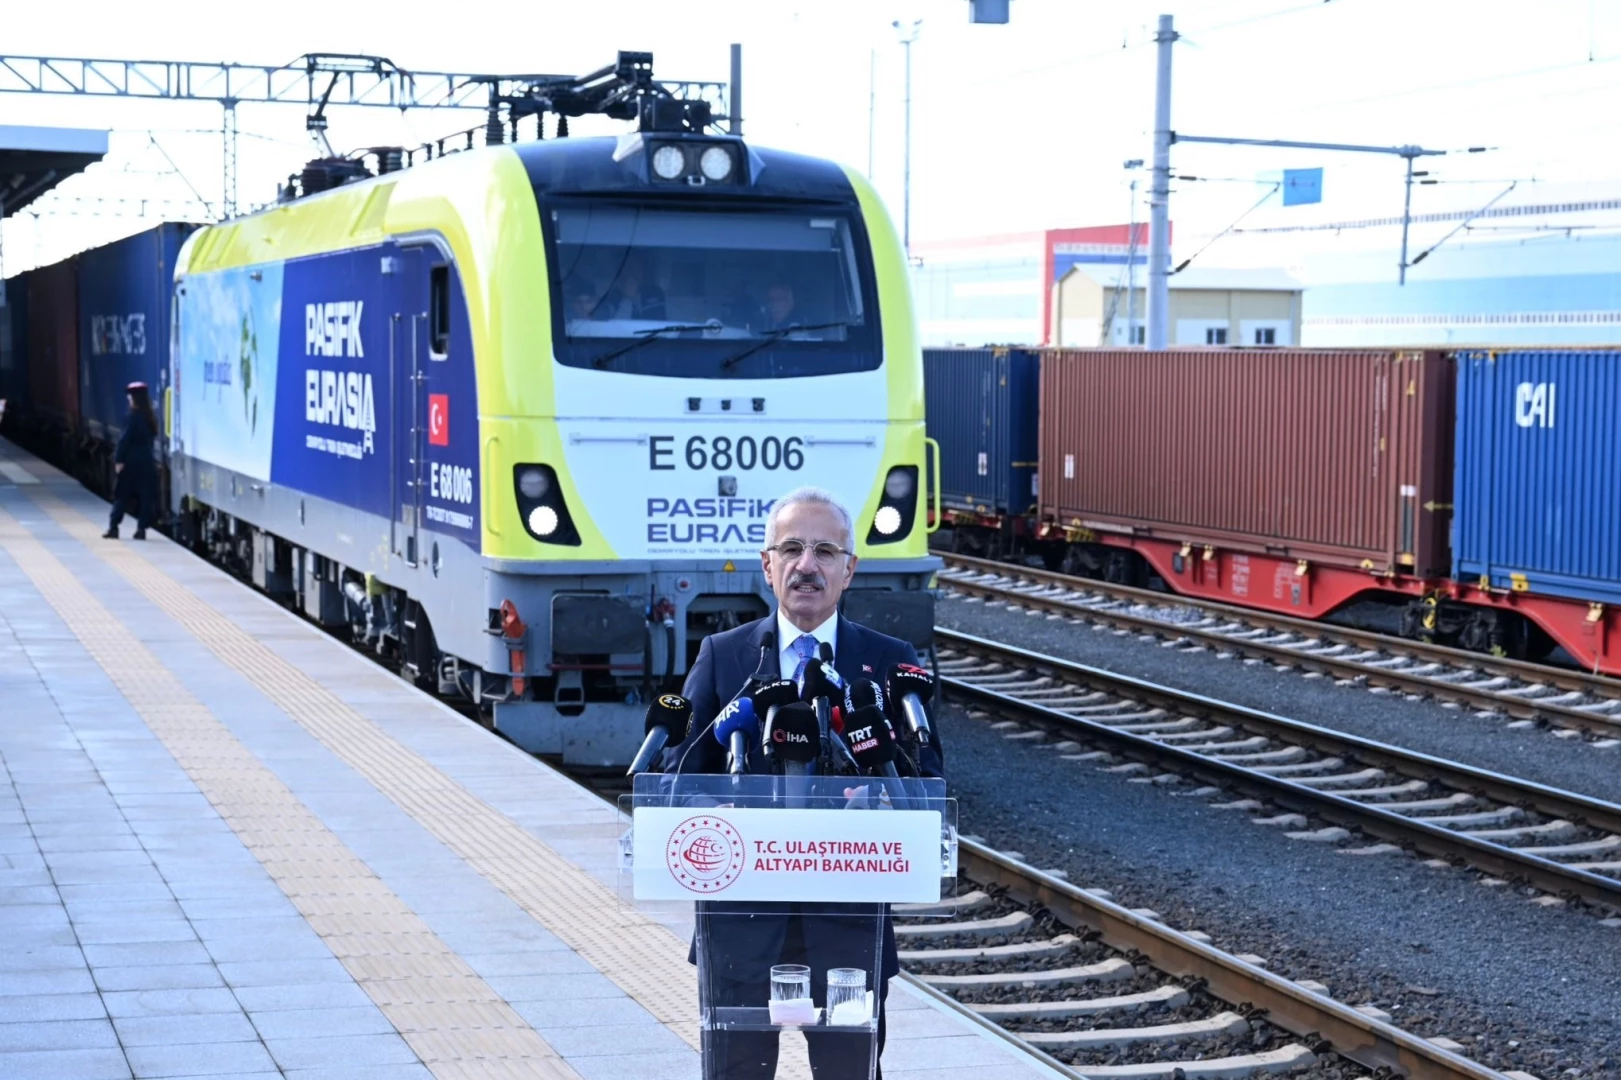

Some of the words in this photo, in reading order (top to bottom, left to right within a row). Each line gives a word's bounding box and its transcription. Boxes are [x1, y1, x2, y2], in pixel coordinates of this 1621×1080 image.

[306, 369, 376, 434] EURASIA
[1515, 382, 1556, 428] CAI
[649, 436, 675, 470] E
[685, 436, 804, 471] 68006
[430, 462, 439, 497] E
[664, 696, 681, 706] 24
[786, 731, 809, 743] İHA
[848, 726, 873, 744] TRT
[852, 738, 878, 754] HABER
[754, 840, 782, 854] T.C.
[785, 841, 879, 857] ULAŞTIRMA
[882, 842, 902, 855] VE
[754, 858, 818, 872] ALTYAPI
[822, 857, 909, 873] BAKANLIĞI
